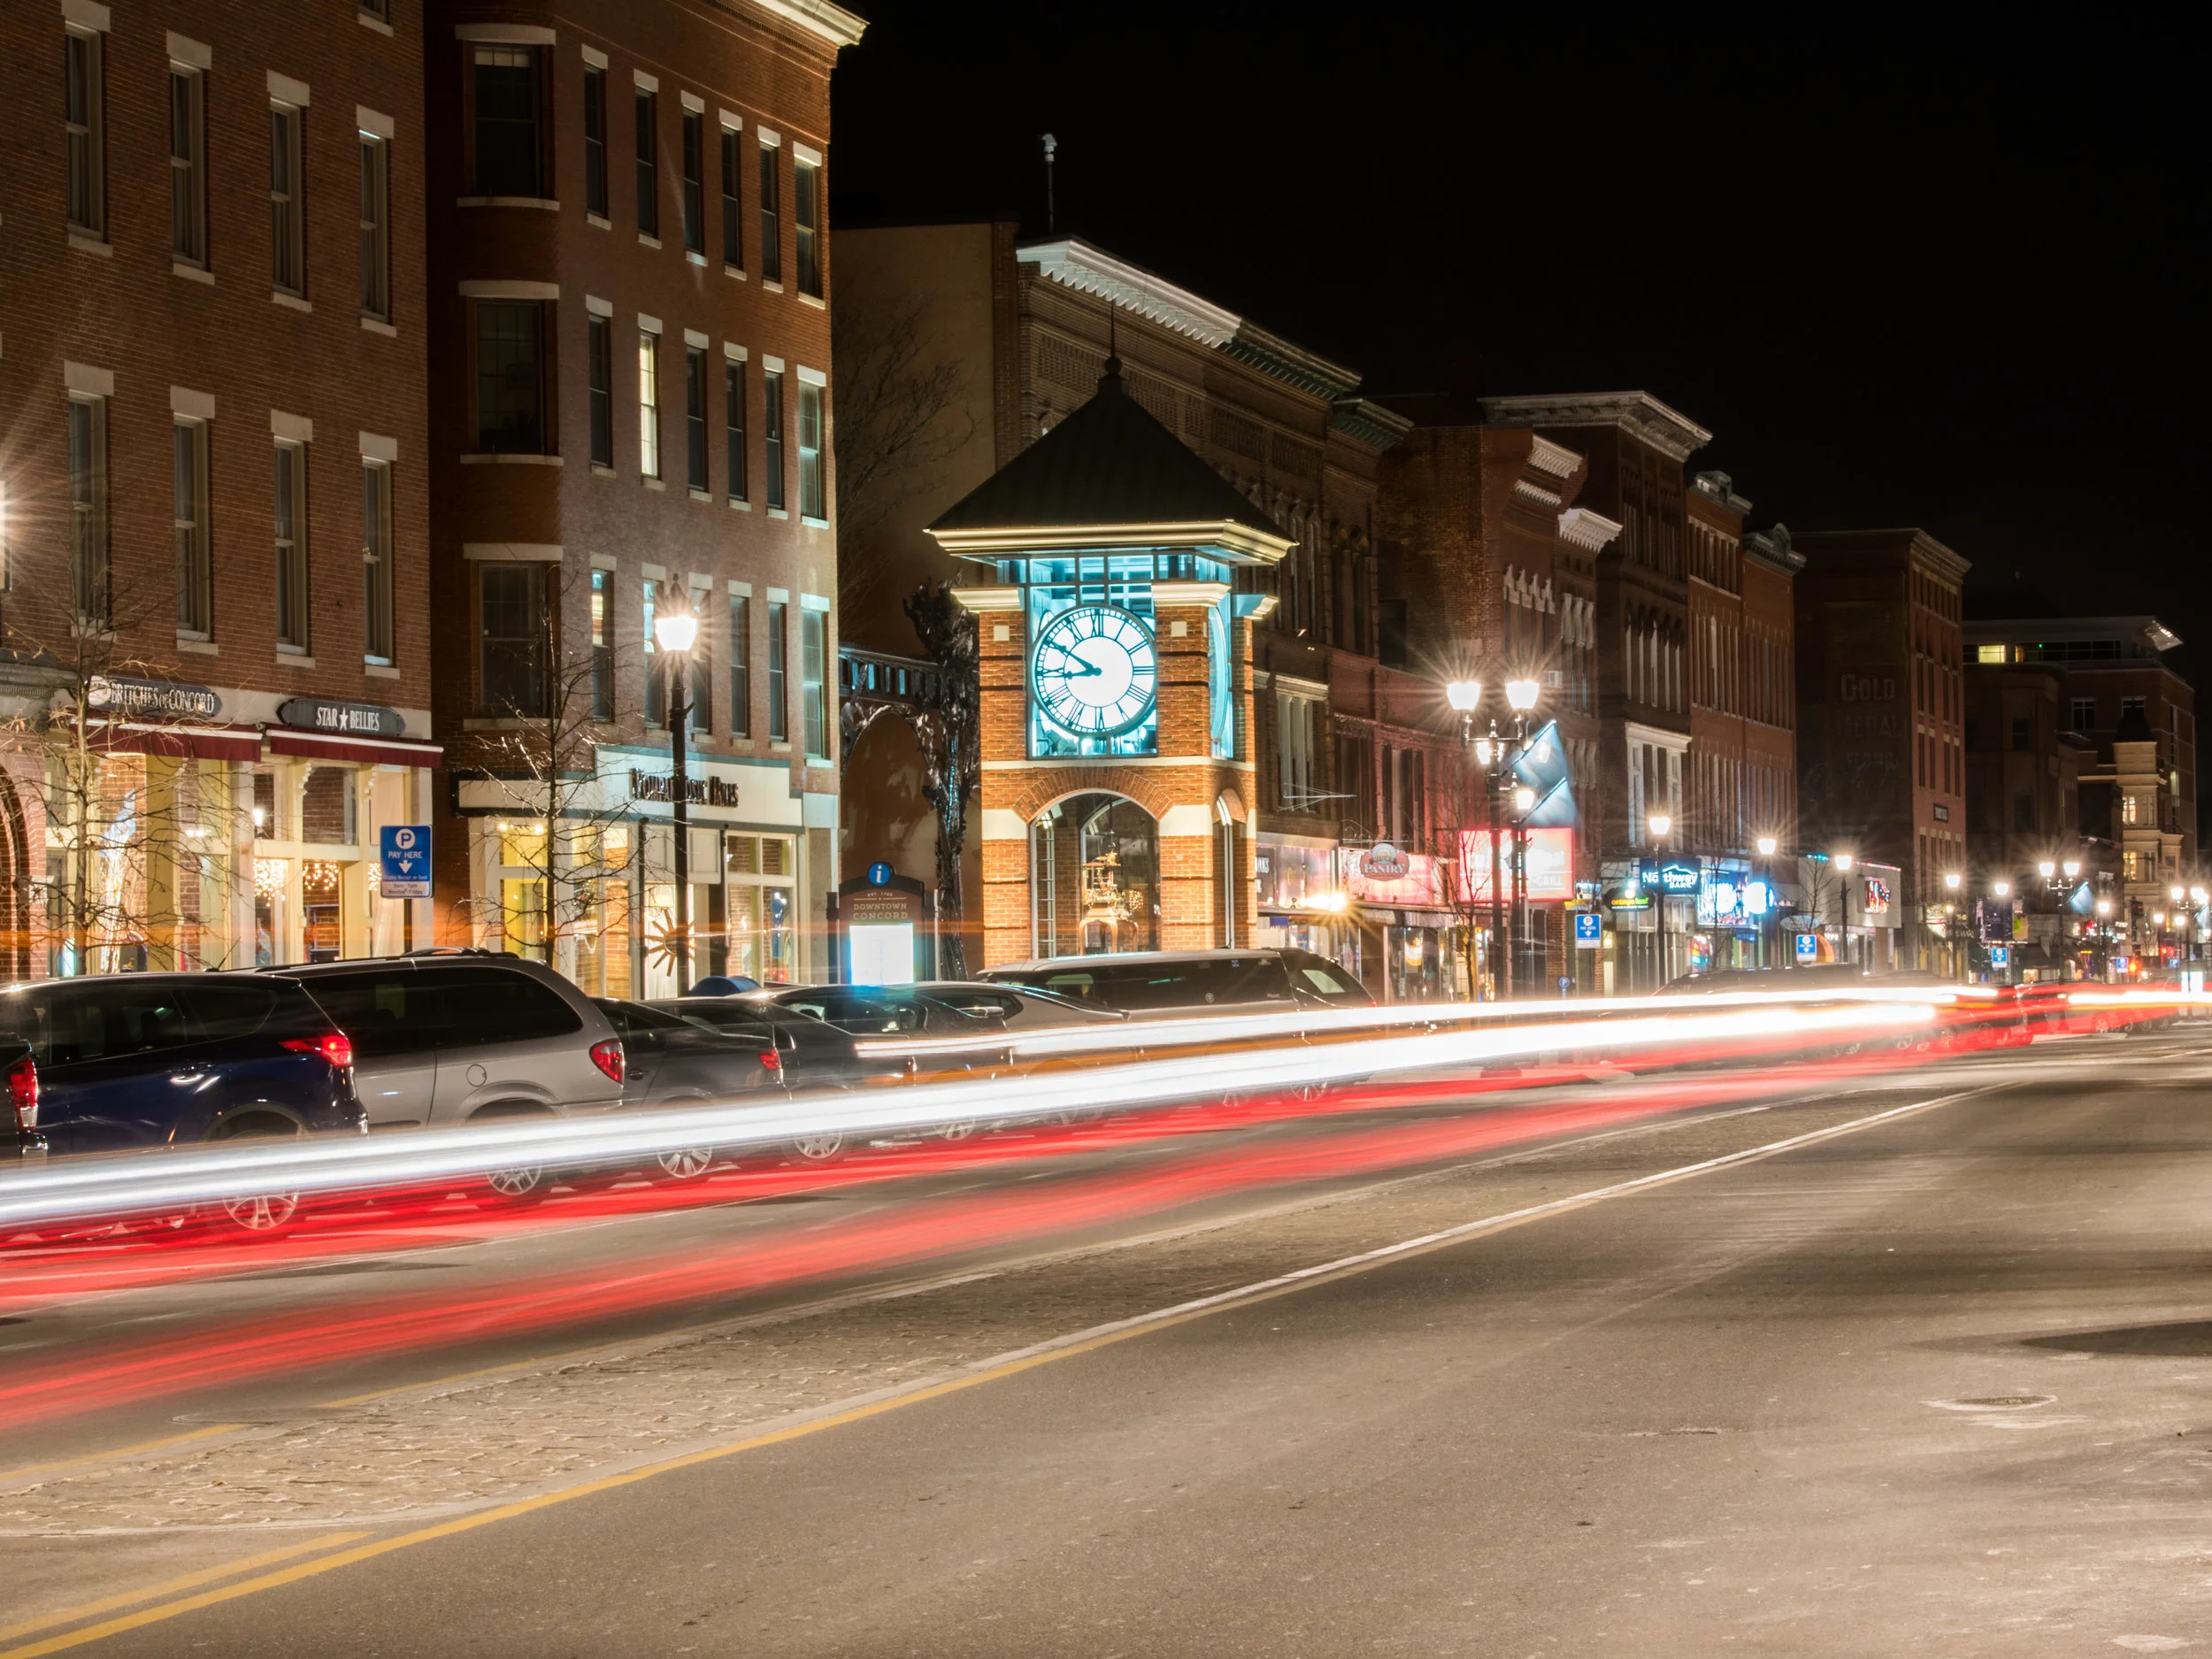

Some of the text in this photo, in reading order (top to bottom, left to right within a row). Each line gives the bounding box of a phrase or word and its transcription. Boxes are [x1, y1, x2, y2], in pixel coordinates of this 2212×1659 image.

[111, 683, 159, 708] BRITCHES
[169, 689, 215, 713] CONCORD
[316, 706, 380, 732] STAR BELLIES
[401, 833, 411, 847] P
[1363, 863, 1406, 874] PANTRY
[1642, 871, 1698, 885] Nothway
[853, 911, 908, 920] CONCORD
